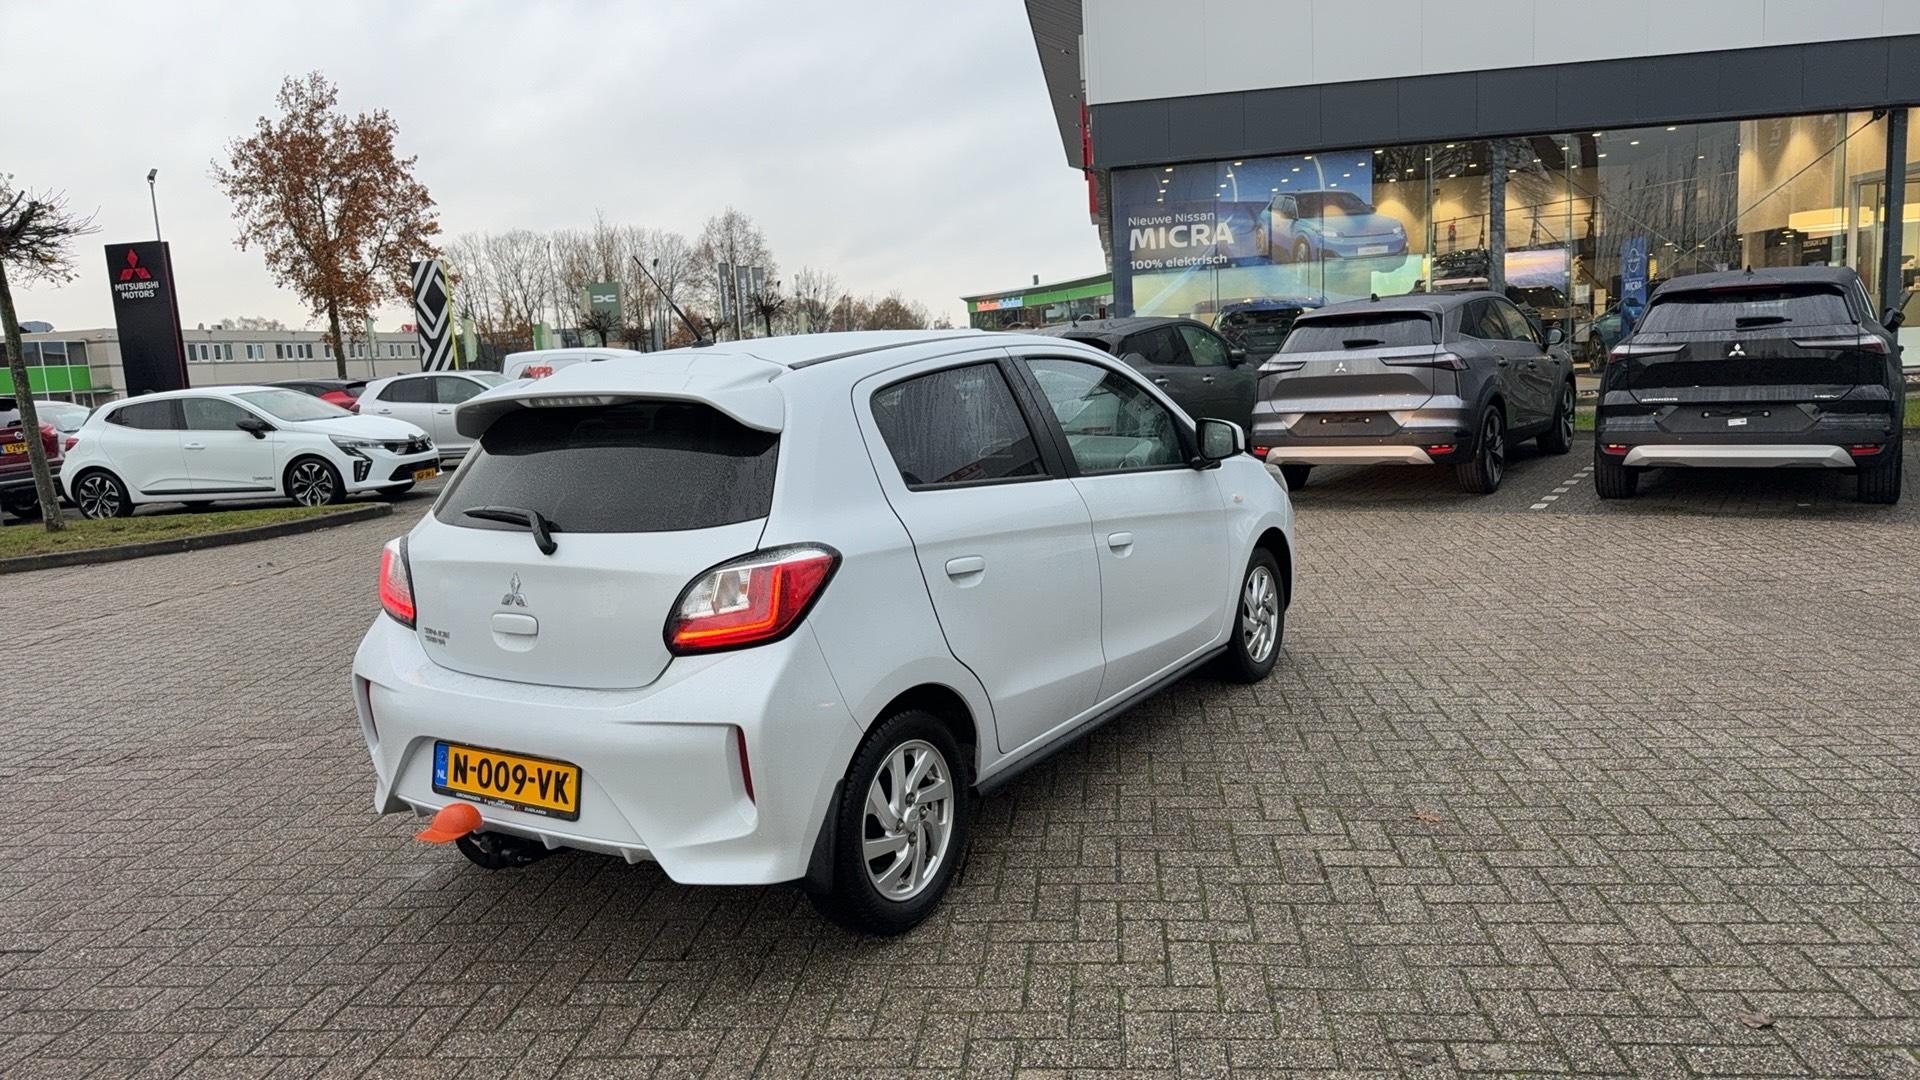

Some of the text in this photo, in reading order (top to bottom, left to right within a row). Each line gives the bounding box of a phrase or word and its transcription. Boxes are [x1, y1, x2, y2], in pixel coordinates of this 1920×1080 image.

[1128, 212, 1215, 226] Nieuwe Nissan
[1129, 222, 1235, 251] MICRA
[1130, 254, 1228, 270] 100% elektrisch
[114, 281, 160, 291] MITSUBISHI
[121, 290, 155, 299] MOTORS
[437, 769, 446, 779] NL
[453, 753, 569, 804] N-009-VK
